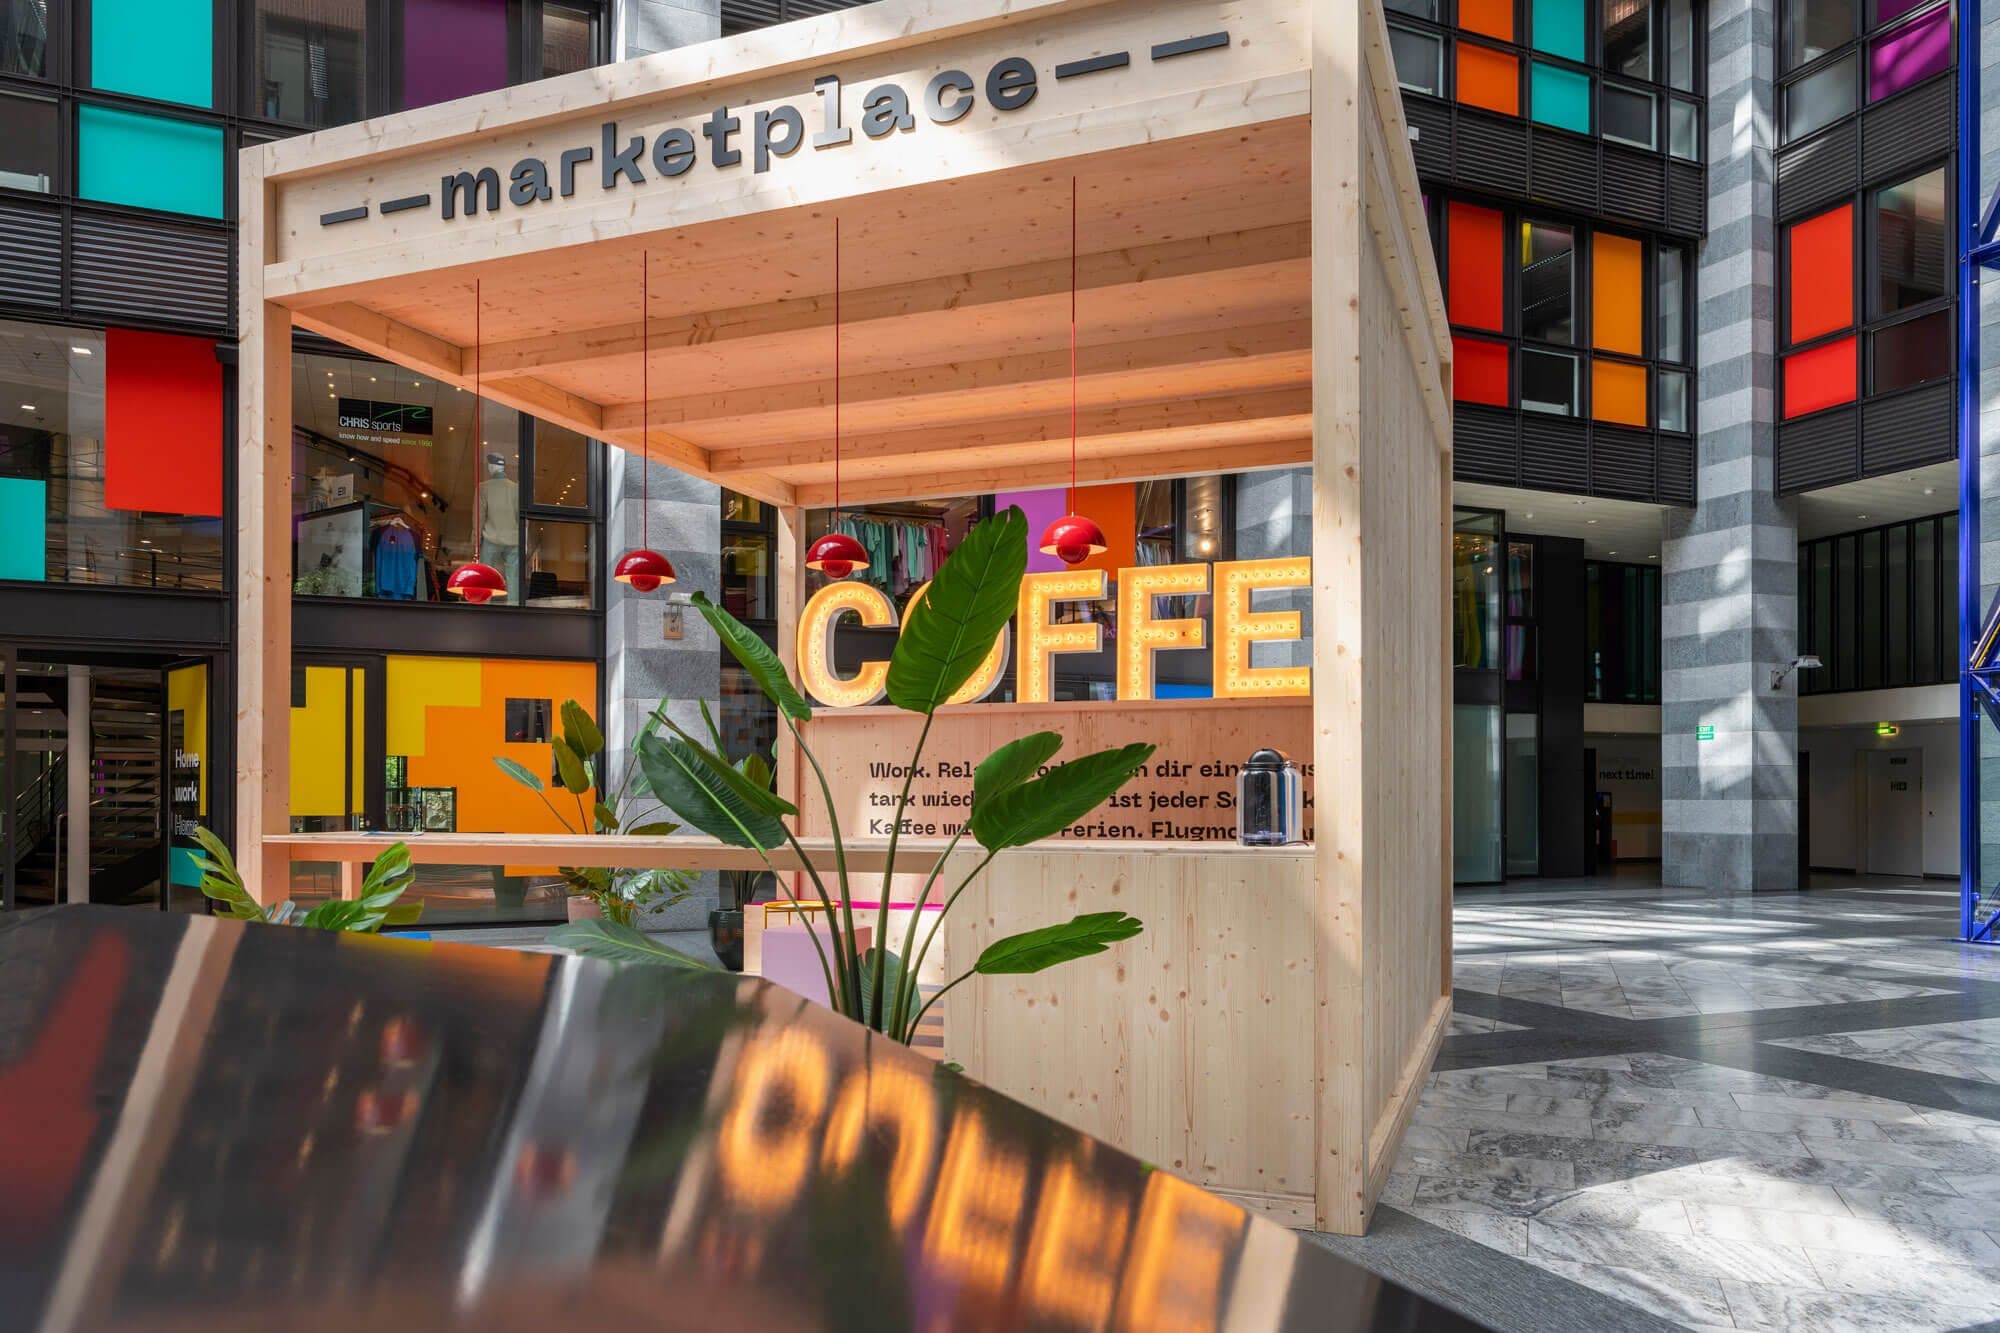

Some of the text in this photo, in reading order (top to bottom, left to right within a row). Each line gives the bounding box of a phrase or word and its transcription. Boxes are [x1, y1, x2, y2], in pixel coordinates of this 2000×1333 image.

[339, 416, 401, 432] CHRIS sports
[339, 432, 356, 440] know
[175, 748, 200, 769] Home
[1156, 760, 1193, 778] dir
[1599, 768, 1623, 780] next
[175, 781, 198, 802] work
[1108, 791, 1142, 808] ist
[1149, 791, 1209, 812] jeder
